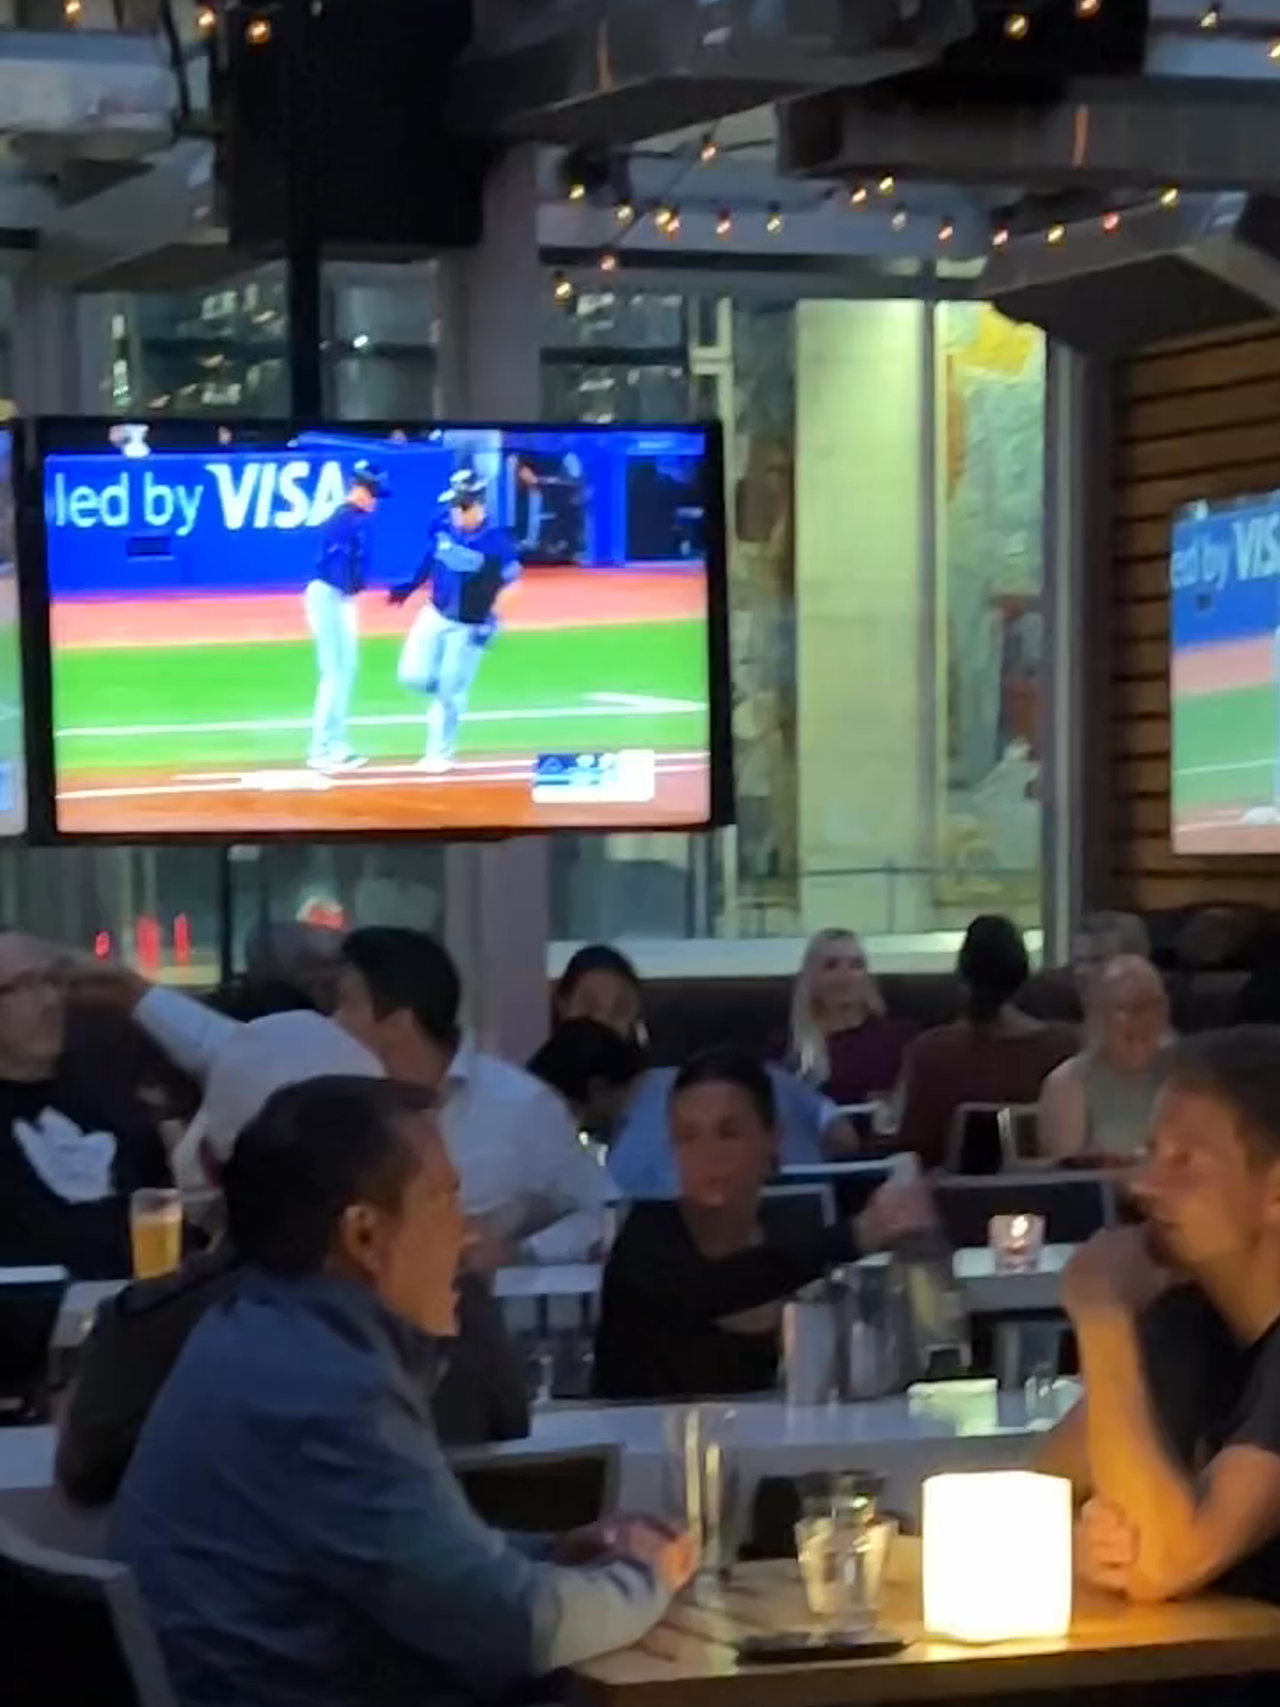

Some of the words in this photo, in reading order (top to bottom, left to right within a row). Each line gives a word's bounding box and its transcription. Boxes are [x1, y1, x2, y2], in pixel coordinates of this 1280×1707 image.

[55, 472, 129, 528] led
[143, 470, 204, 536] by
[205, 460, 344, 530] VISA
